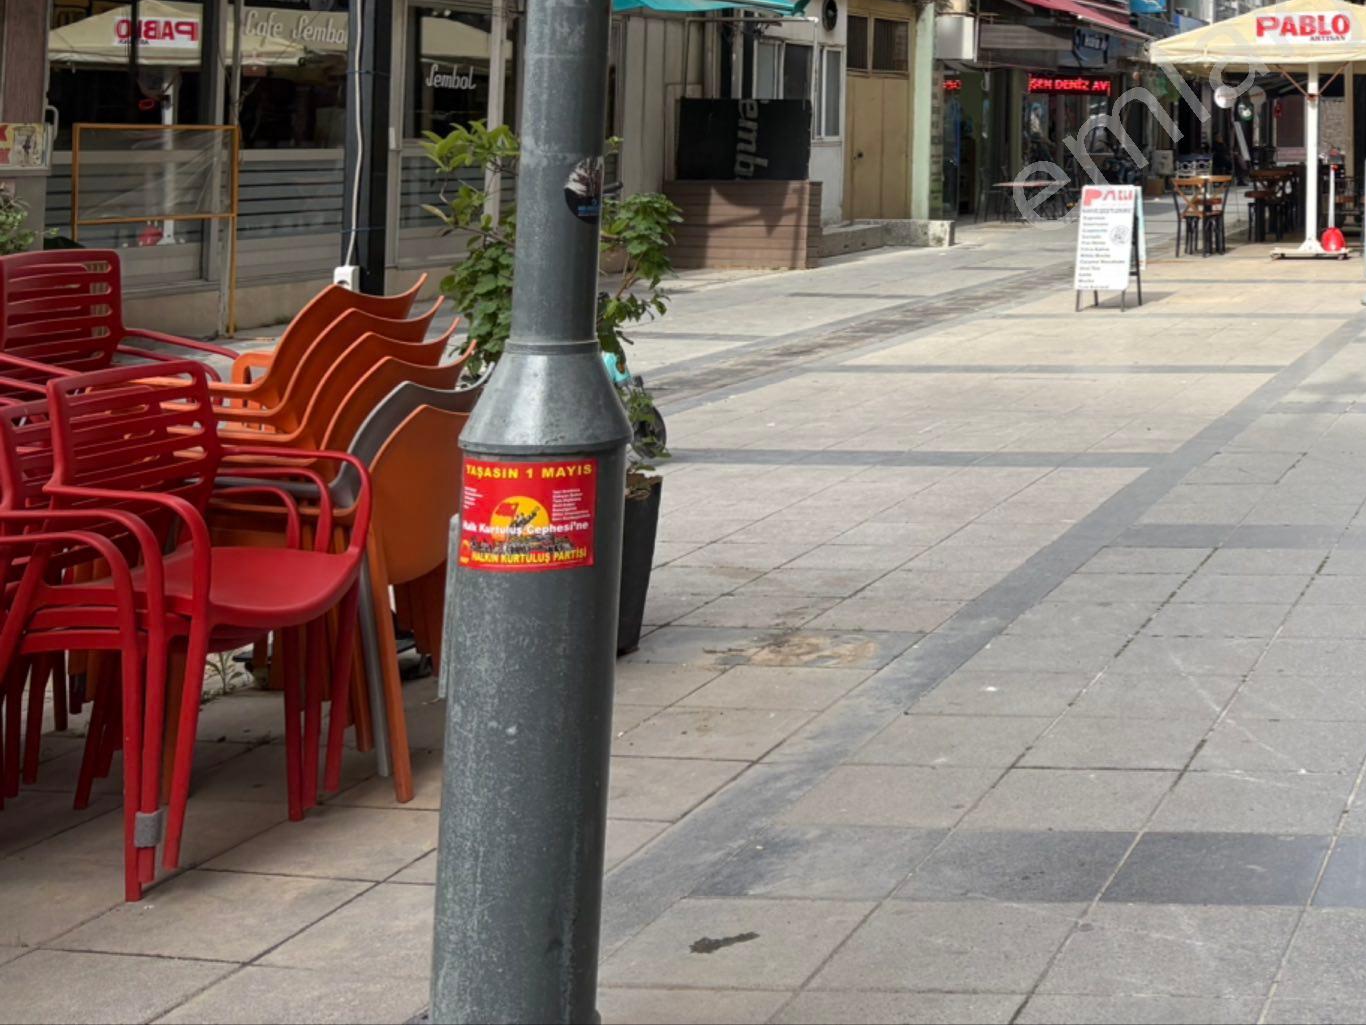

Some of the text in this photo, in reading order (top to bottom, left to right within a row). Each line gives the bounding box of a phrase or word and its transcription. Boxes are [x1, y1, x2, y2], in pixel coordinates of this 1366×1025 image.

[1256, 14, 1351, 38] PABLO
[425, 63, 477, 90] Sembol
[526, 466, 534, 479] 1
[541, 464, 593, 478] MAYIS
